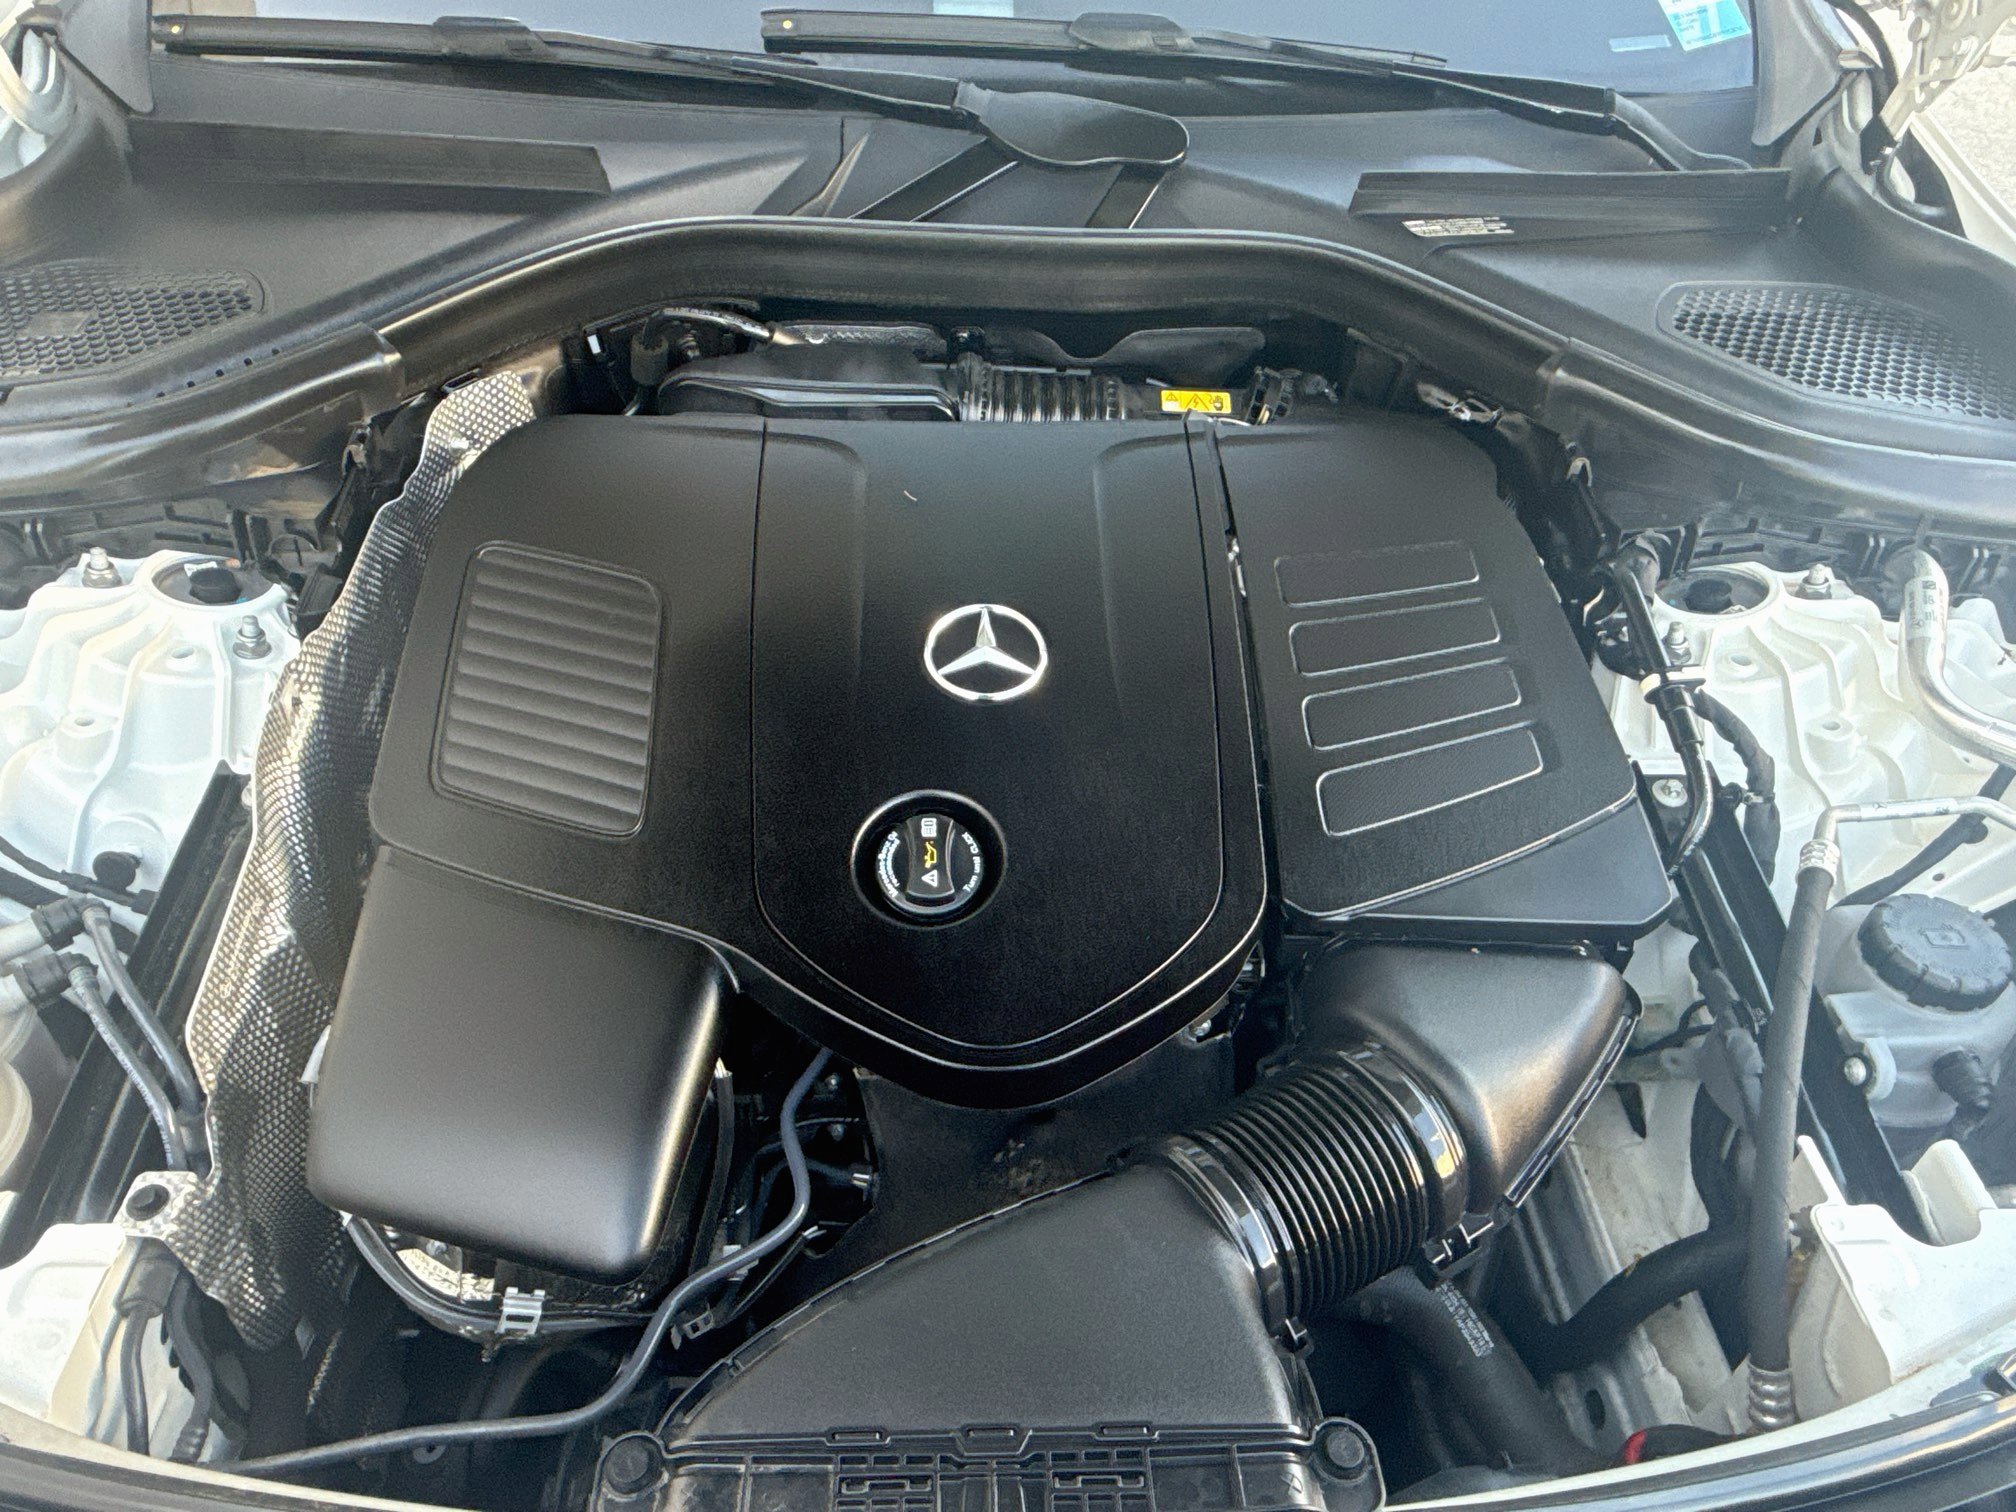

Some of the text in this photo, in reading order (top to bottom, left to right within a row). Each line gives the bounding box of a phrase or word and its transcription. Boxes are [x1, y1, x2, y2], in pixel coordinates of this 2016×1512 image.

[878, 840, 898, 897] Mercedes-Benz
[961, 831, 981, 892] Turn until CLICK
